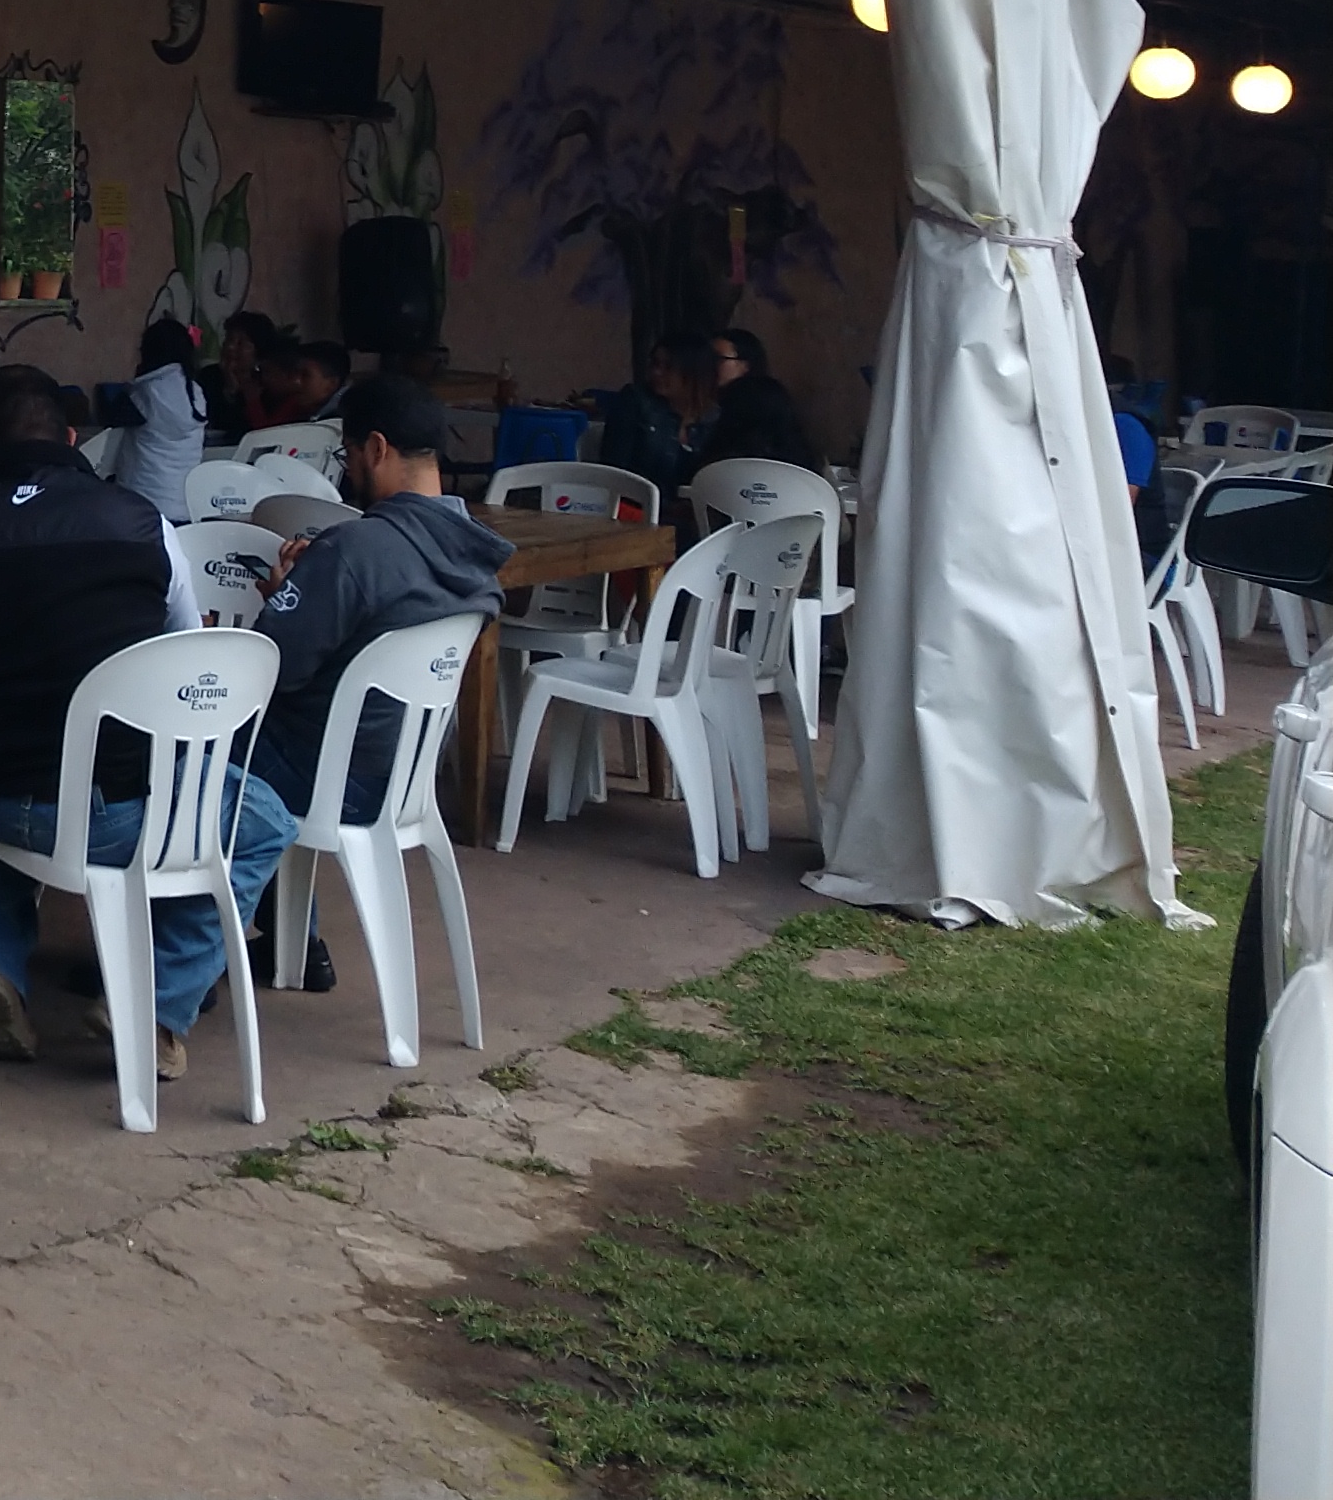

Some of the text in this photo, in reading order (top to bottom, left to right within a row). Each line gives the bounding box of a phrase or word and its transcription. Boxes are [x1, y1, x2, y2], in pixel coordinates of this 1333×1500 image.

[16, 485, 38, 496] NIKE
[218, 576, 247, 591] Extra
[177, 685, 228, 703] Corona
[191, 700, 218, 711] Extra
